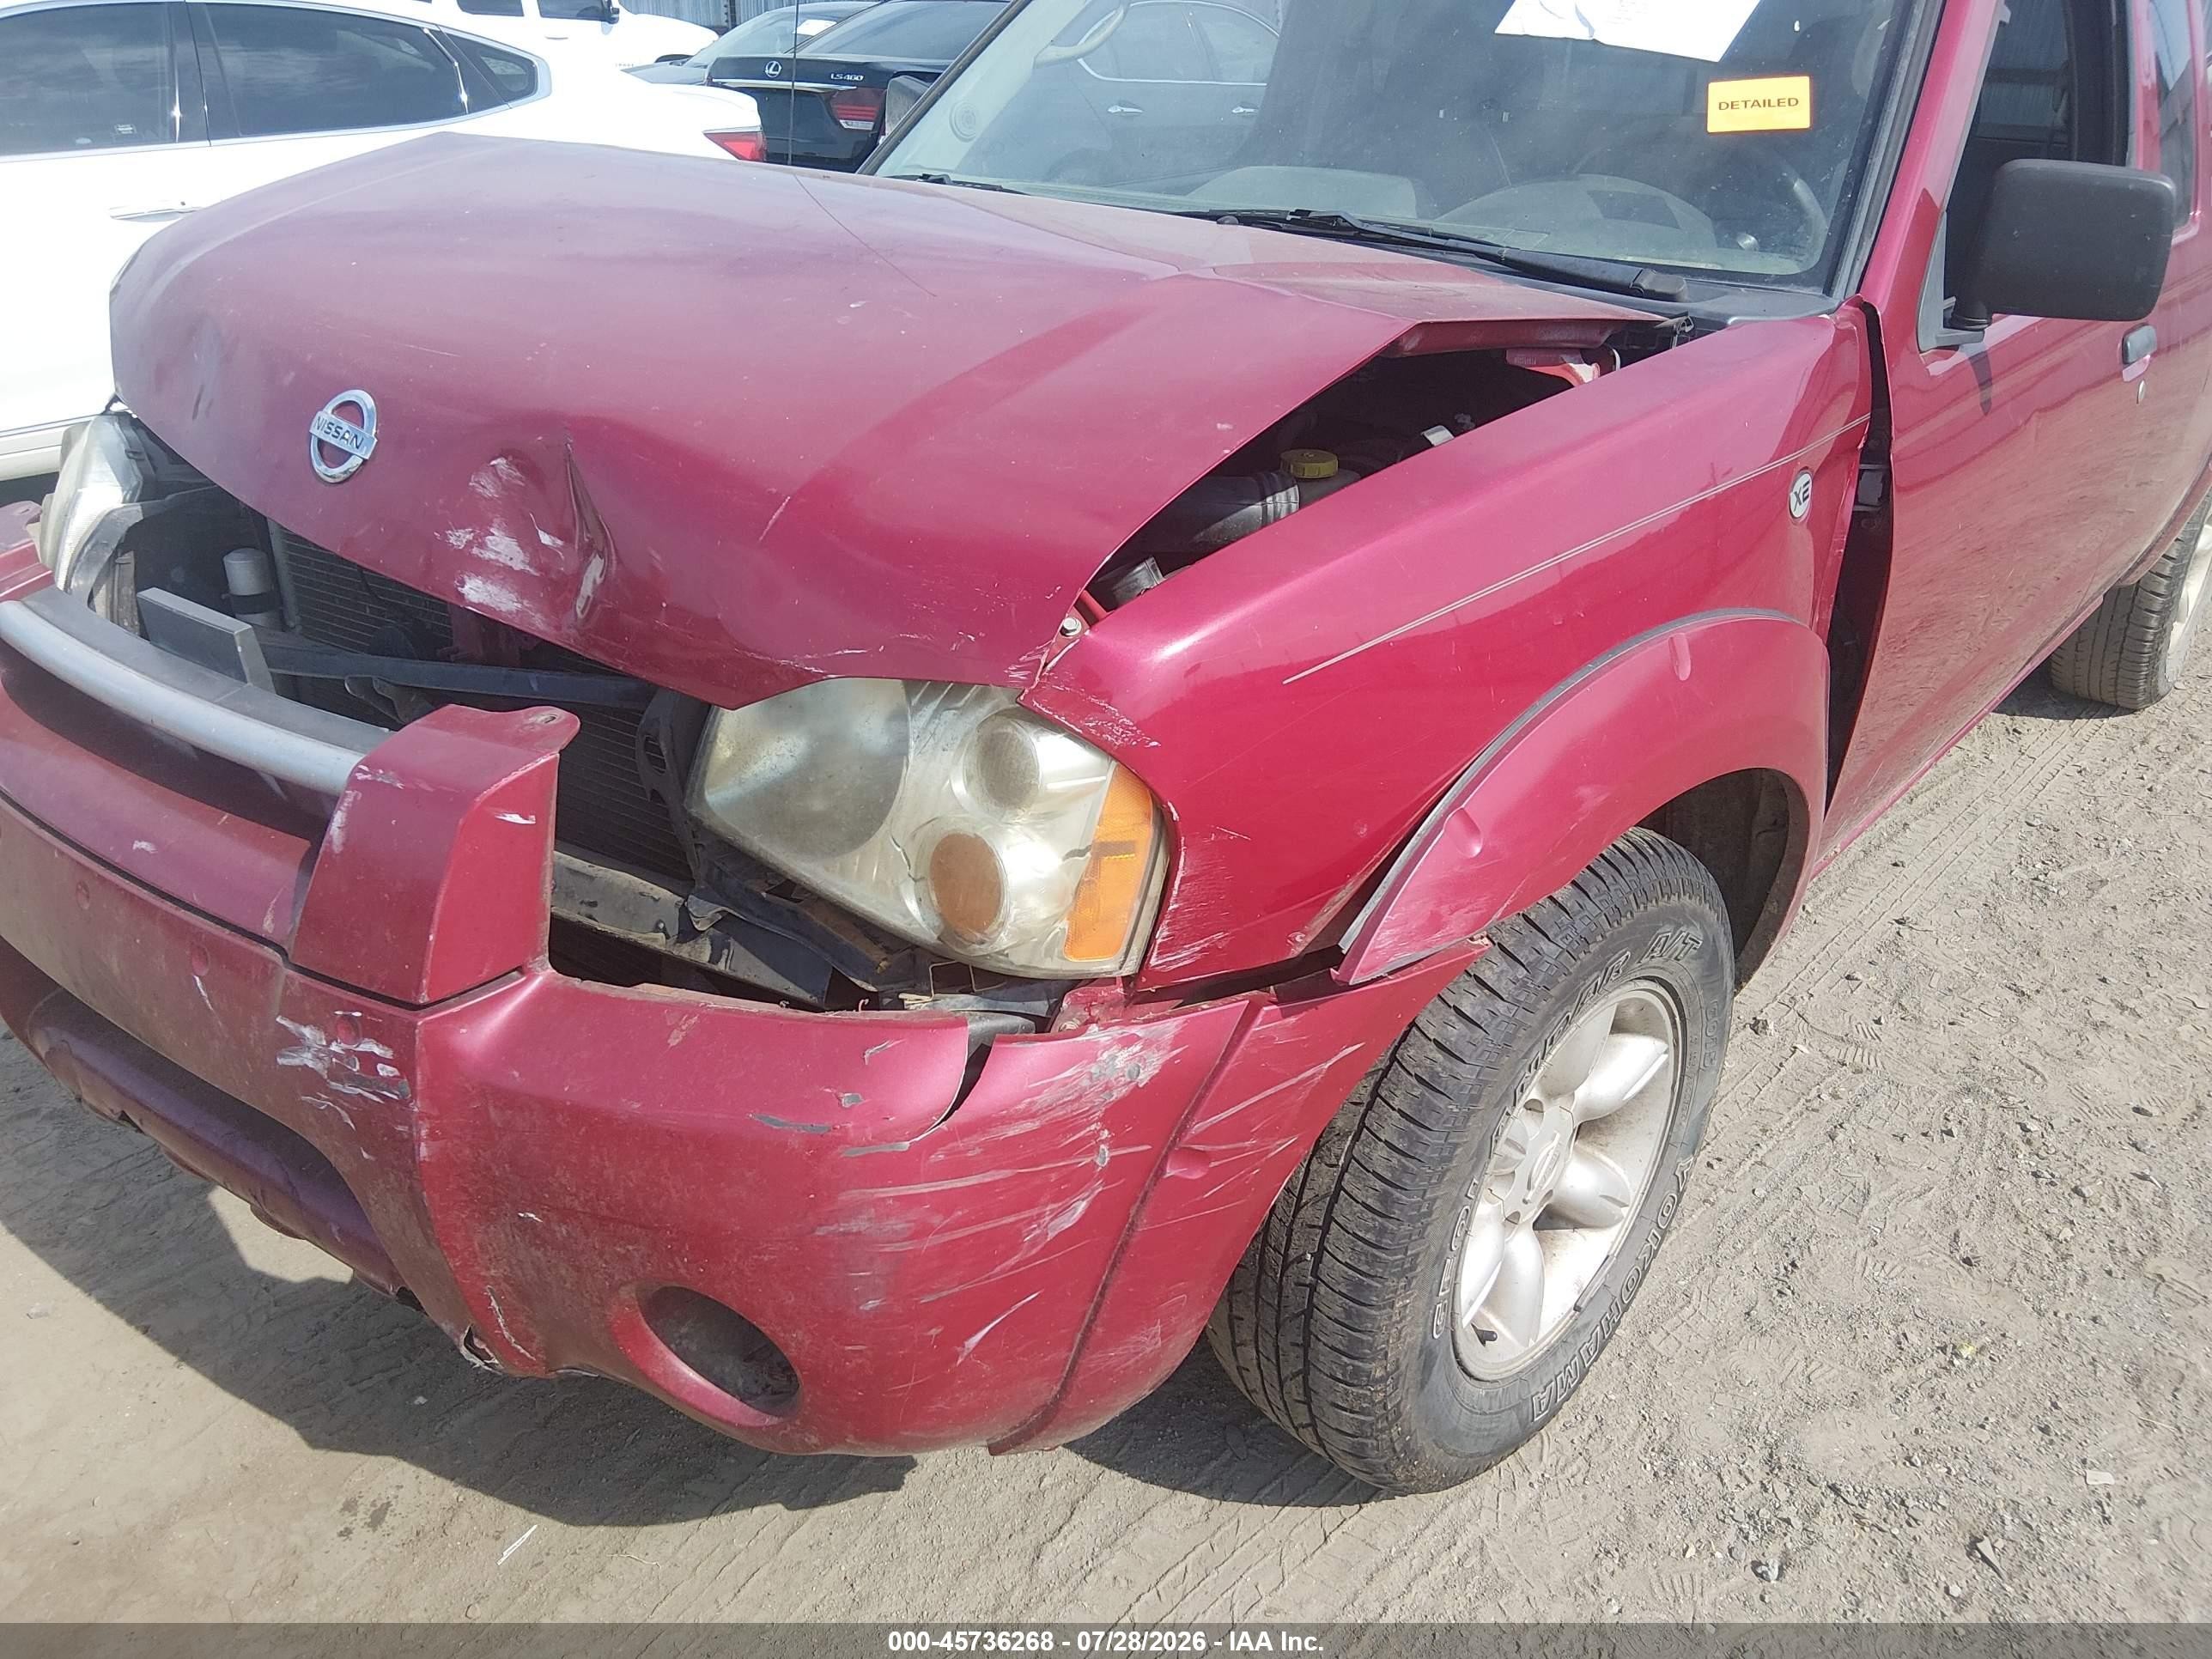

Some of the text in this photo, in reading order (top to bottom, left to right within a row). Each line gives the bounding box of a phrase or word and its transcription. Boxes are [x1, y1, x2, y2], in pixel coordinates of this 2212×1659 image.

[1718, 97, 1799, 111] DETAILED
[315, 416, 364, 449] NISSAN
[1793, 479, 1810, 513] XE
[1637, 930, 1703, 963] A/T
[1532, 1157, 1694, 1422] YOKOHAMA
